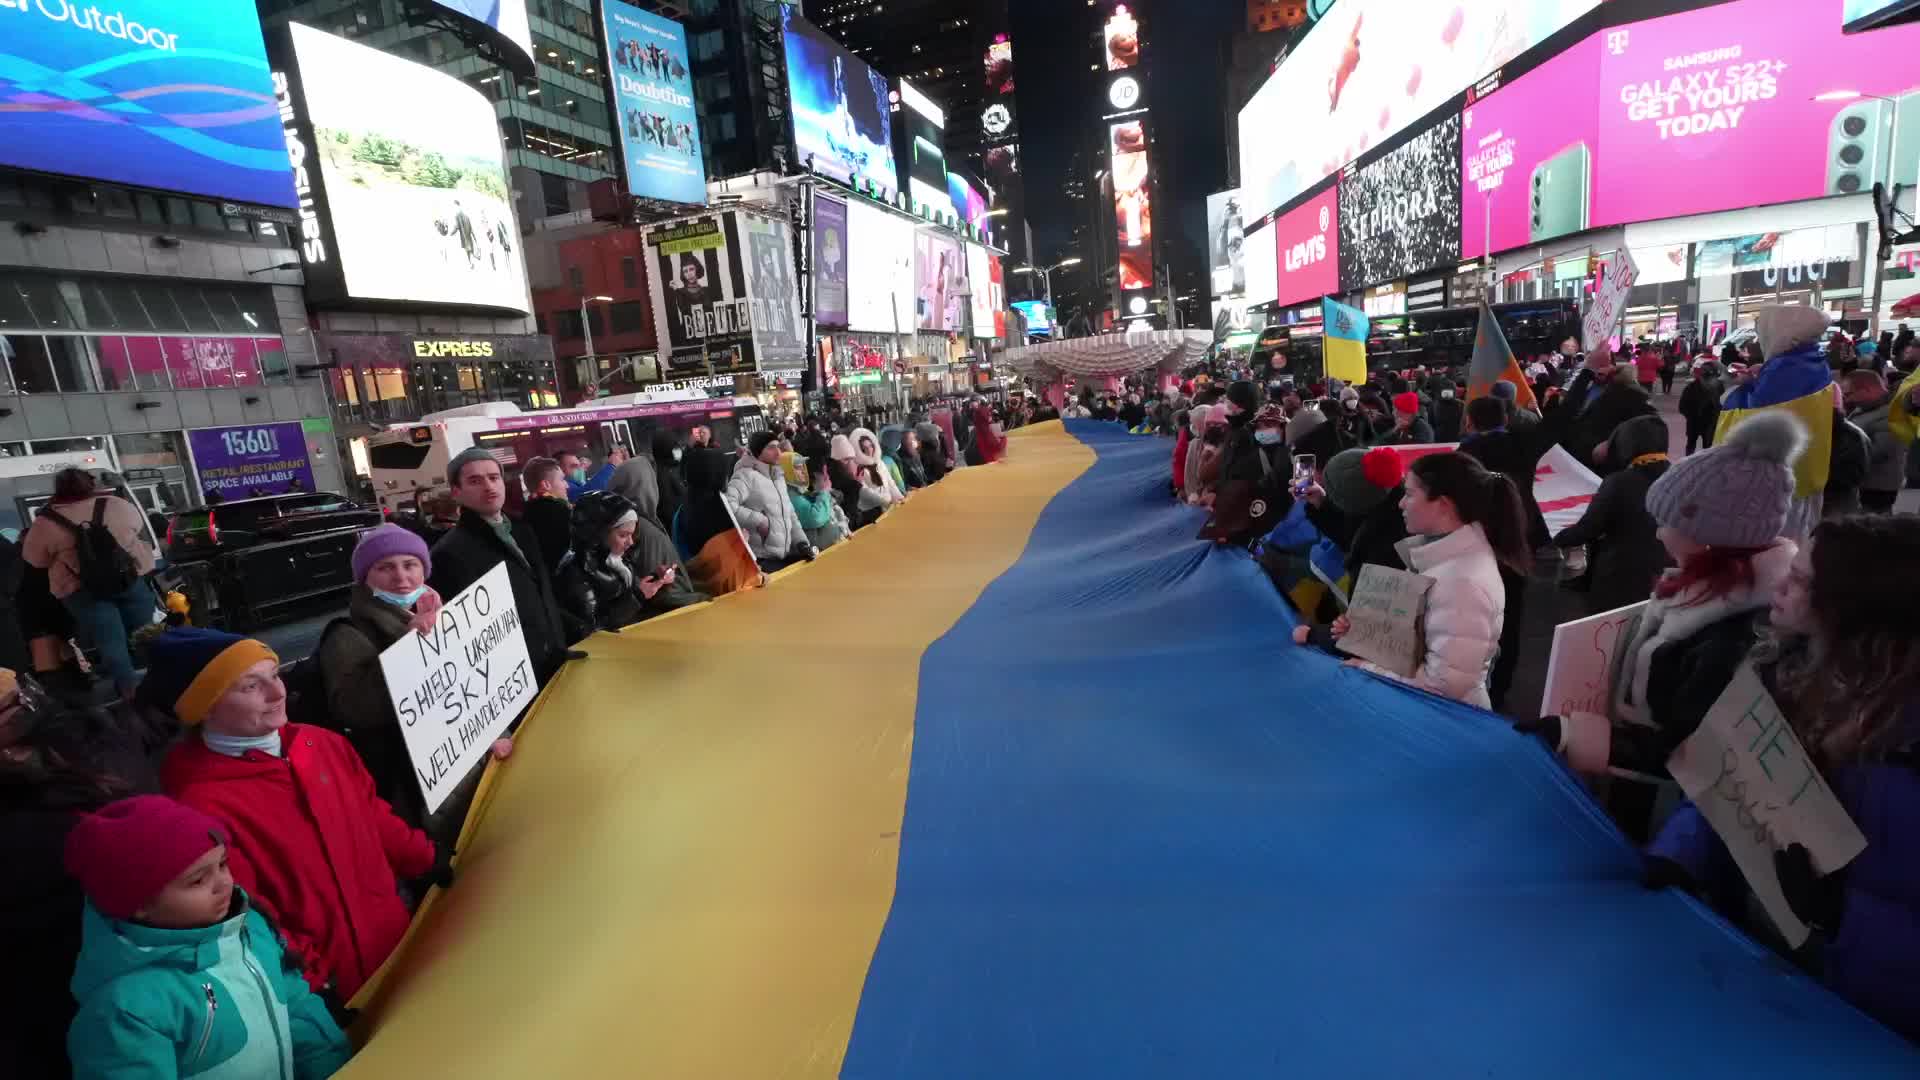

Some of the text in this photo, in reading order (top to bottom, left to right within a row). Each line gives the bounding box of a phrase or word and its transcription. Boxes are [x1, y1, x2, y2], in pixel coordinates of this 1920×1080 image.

[36, 0, 178, 52] Outdoor
[1663, 44, 1742, 71] SAMSUNG
[619, 75, 692, 108] Doubtfire
[1620, 59, 1788, 105] GALAXY S22+
[1627, 76, 1777, 121] GET YOURS
[1655, 105, 1744, 140] TODAY
[1351, 183, 1438, 245] SEPHORA
[414, 341, 493, 357] EXPRESS
[682, 376, 734, 390] LUGGAGE
[205, 471, 294, 490] SPACE AVAILABLE
[417, 585, 490, 667] NATO
[399, 661, 457, 727] SHIELD
[443, 659, 490, 725] SKY
[418, 659, 529, 791] WE'LL HANDLE REST
